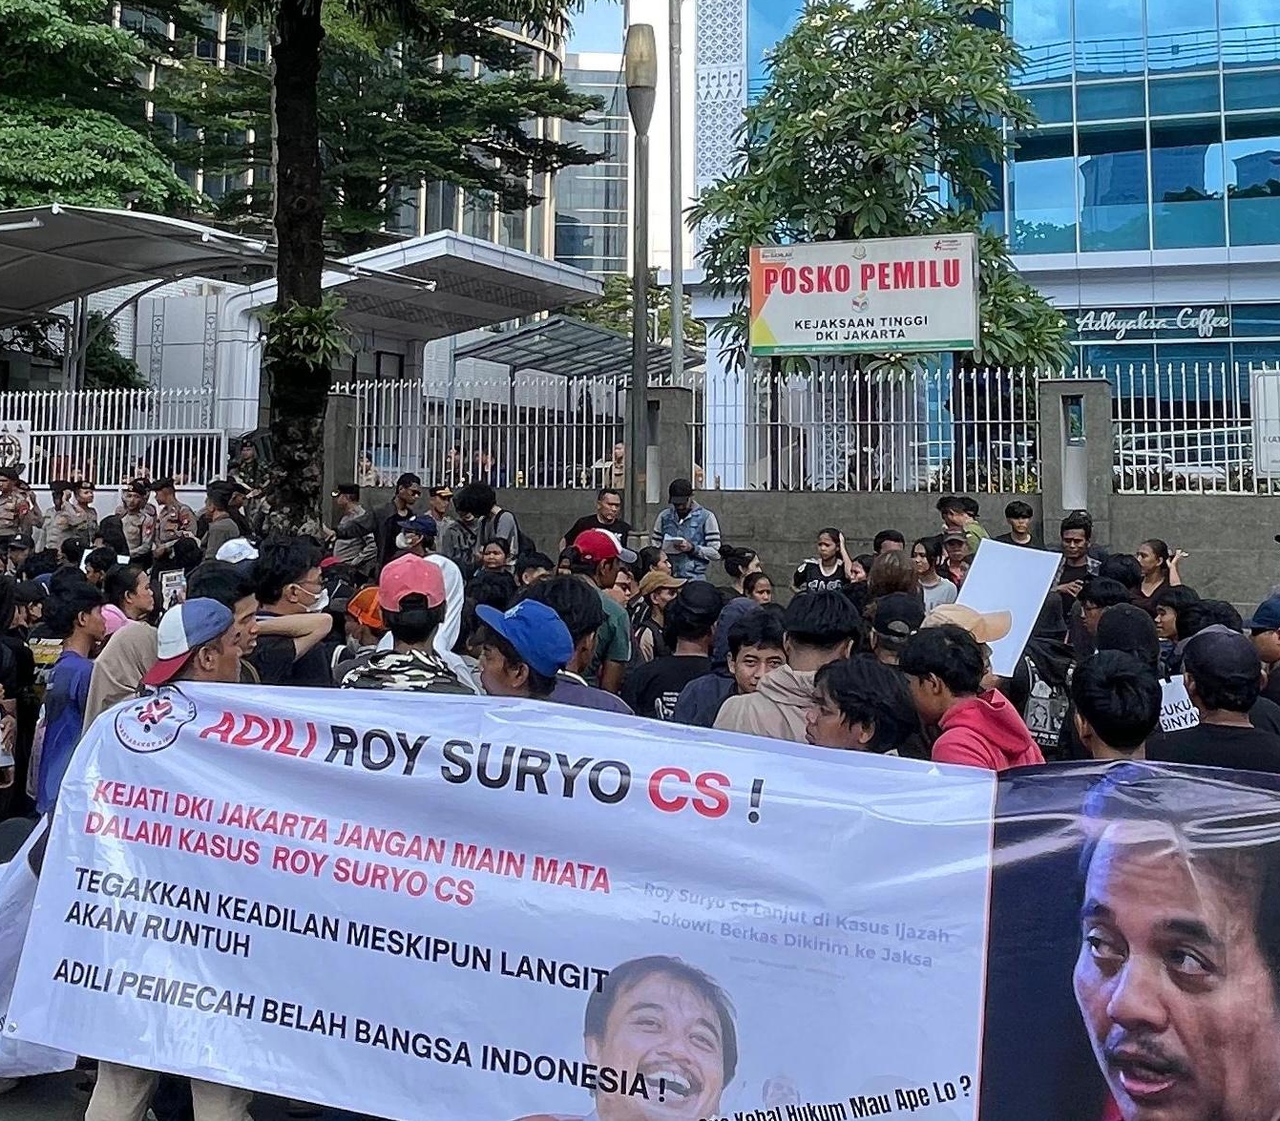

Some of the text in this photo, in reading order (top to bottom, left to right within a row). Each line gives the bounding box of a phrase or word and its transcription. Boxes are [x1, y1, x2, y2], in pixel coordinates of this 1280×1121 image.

[764, 259, 961, 295] POSKO PEMILU
[794, 315, 928, 329] KEJAKSAAN TINGGI
[815, 329, 906, 341] DKI JAKARTA
[1076, 307, 1229, 340] Adhyaksa Coffee
[199, 711, 765, 824] ADILI ROY SURYO CS !
[85, 811, 477, 906] DALAM KASUS ROY SURYO CS
[92, 780, 611, 894] KEJATI DKI JAKARTA JANGAN MAIN MATA
[64, 901, 138, 936] AKAN
[141, 914, 251, 958] RUNTUH
[75, 866, 610, 993] TEGAKKAN KEADILAN MESKIPUN LANGIT
[643, 881, 673, 904] Roy
[677, 888, 726, 913] Suryo
[812, 913, 831, 928] di
[835, 915, 890, 937] Kasus
[895, 922, 951, 945] Ijazah
[720, 923, 778, 946] Berkas
[783, 933, 850, 958] Dikirim
[854, 943, 877, 961] ke
[880, 947, 934, 969] Jaksa
[52, 958, 667, 1103] ADILI PEMECAH BELAH BANGSA INDONESIA !
[784, 1102, 848, 1121] Hukum
[848, 1088, 892, 1120] Mau
[895, 1084, 931, 1112] Ape
[932, 1080, 958, 1104] Lo
